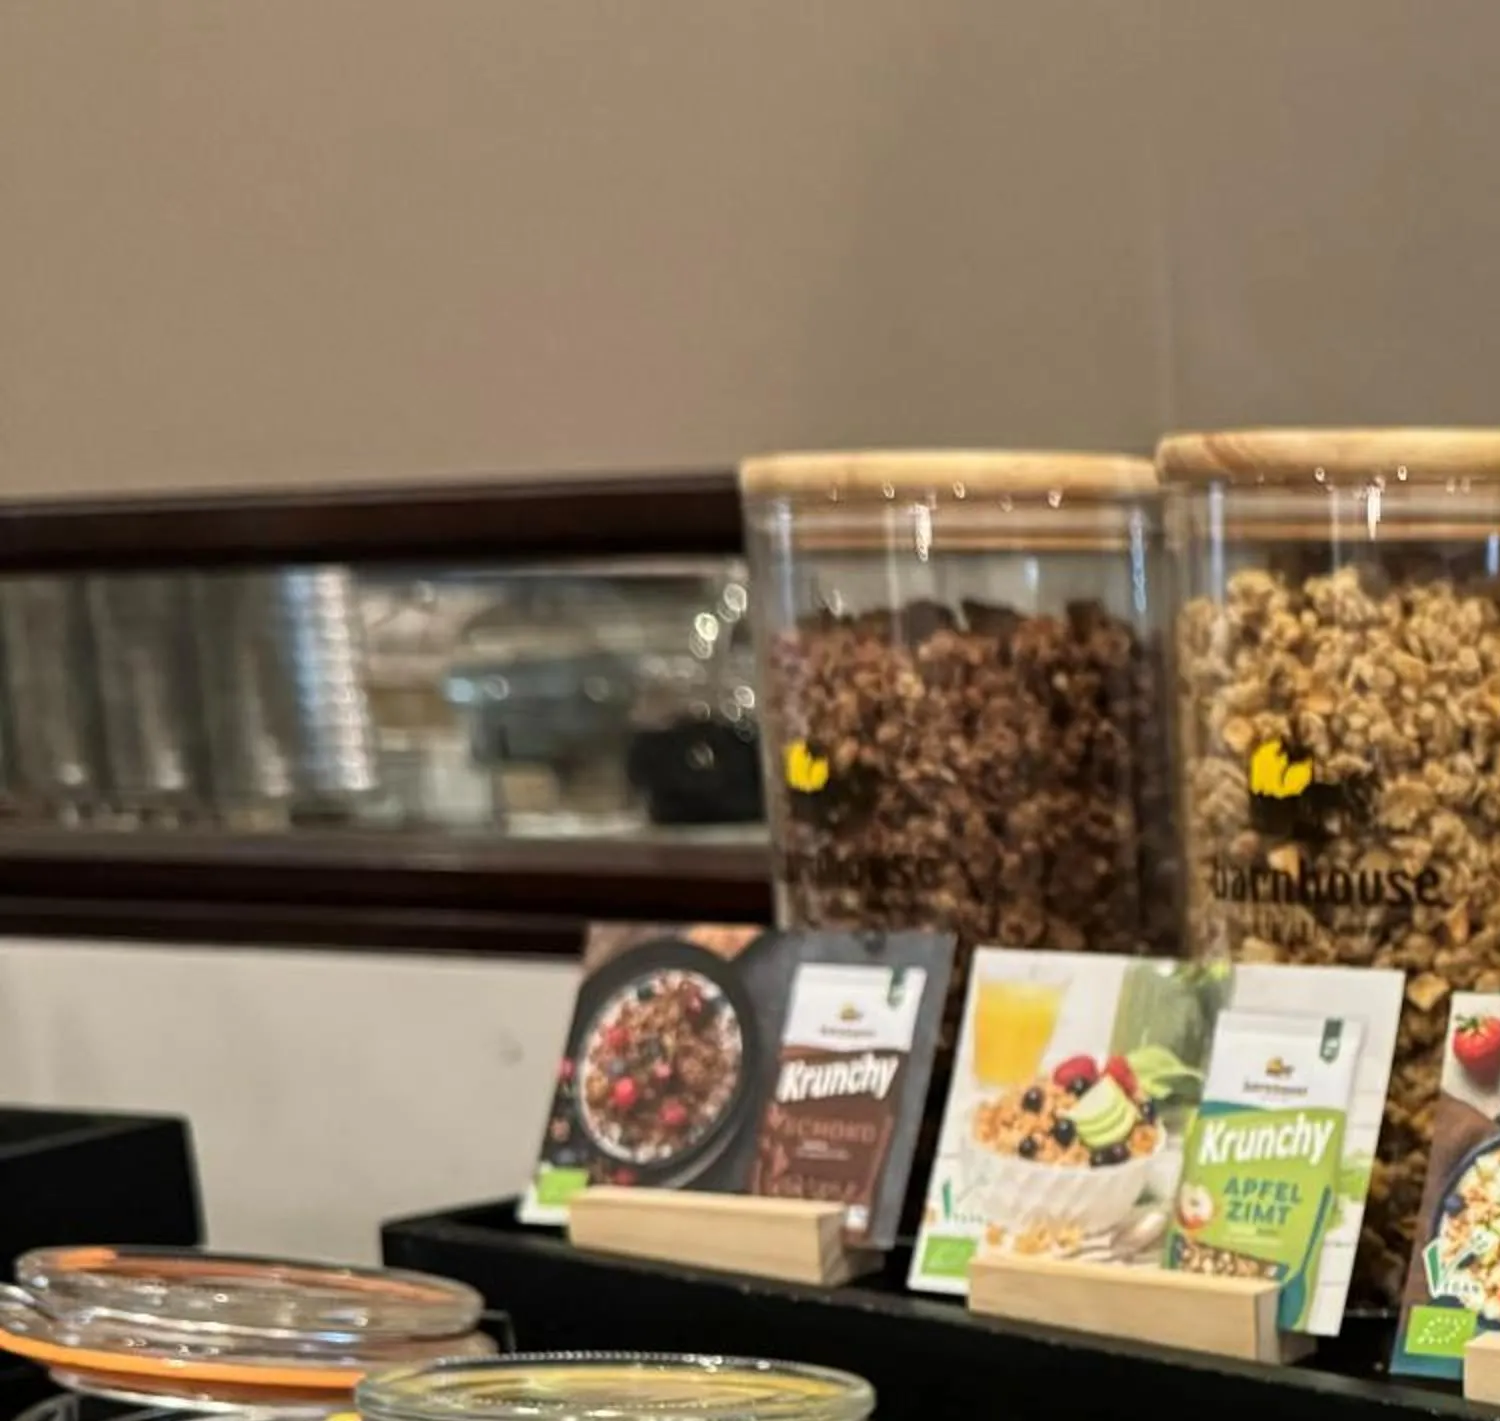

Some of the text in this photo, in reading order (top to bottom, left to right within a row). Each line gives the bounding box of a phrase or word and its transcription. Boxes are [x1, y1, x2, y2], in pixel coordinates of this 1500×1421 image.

[775, 1052, 899, 1103] Krunchy
[1197, 1112, 1336, 1167] Krunchy
[1223, 1175, 1303, 1203] APFEL
[1225, 1200, 1292, 1225] ZIMT
